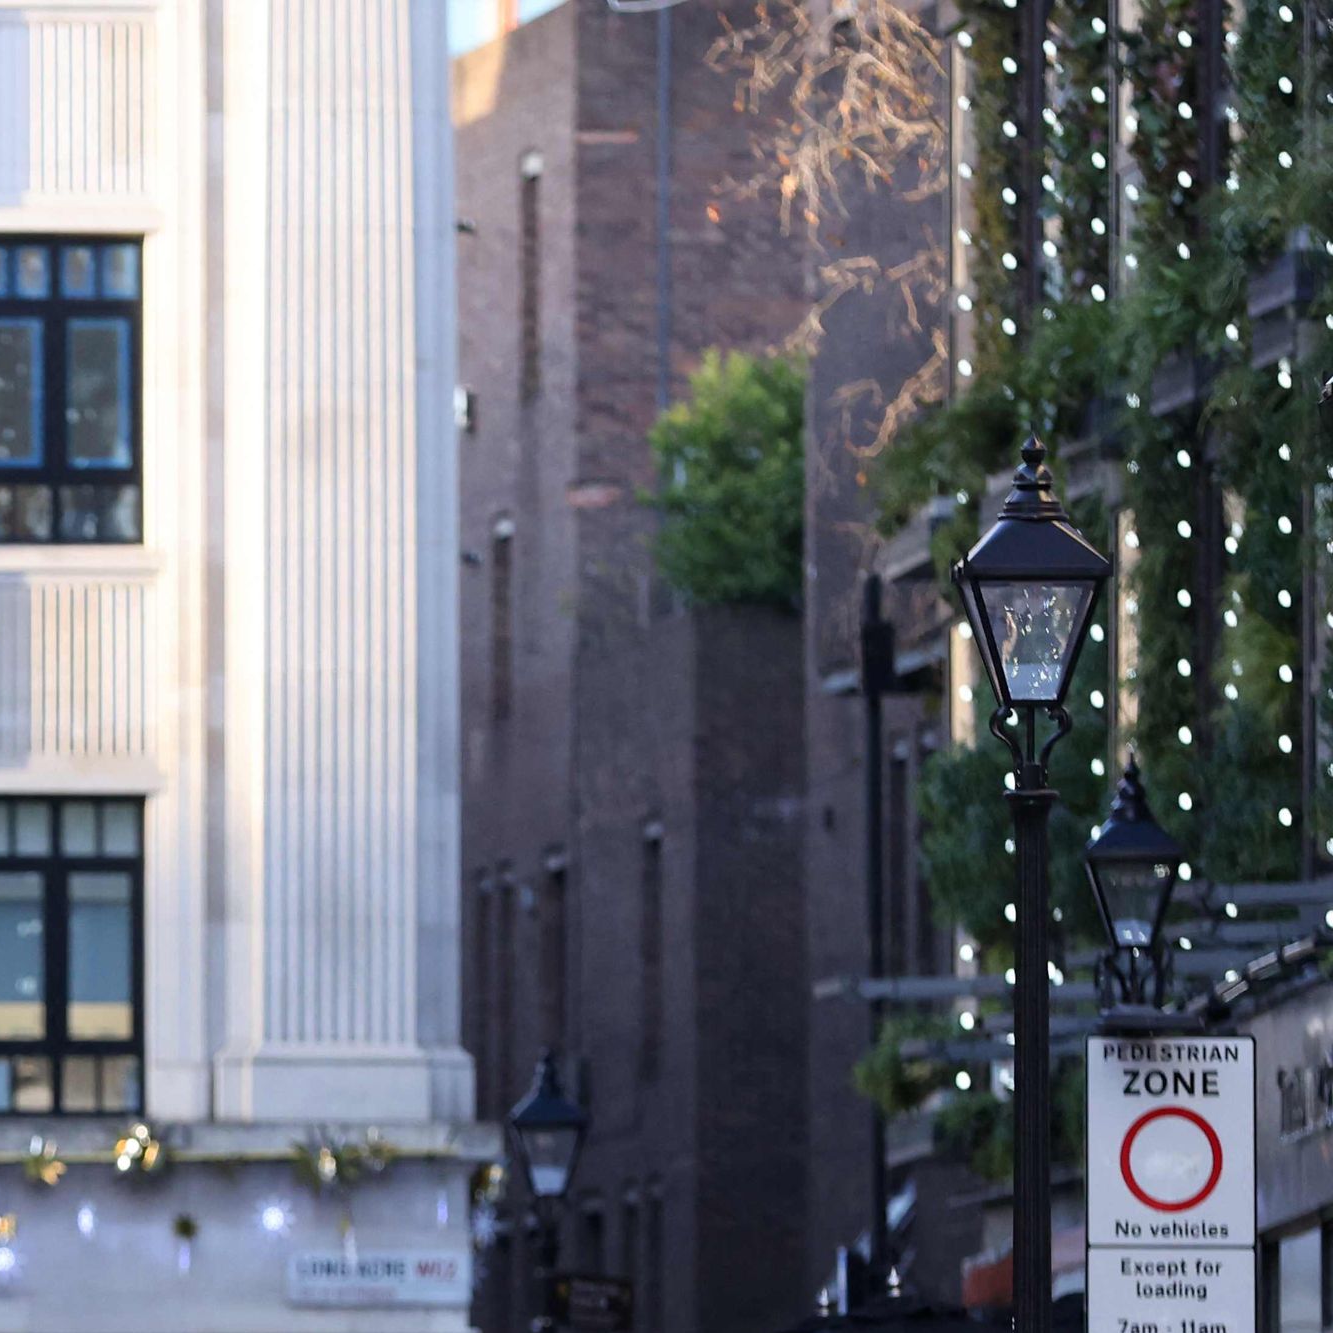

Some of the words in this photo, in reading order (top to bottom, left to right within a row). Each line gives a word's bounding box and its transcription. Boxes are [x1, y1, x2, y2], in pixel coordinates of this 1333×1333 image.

[1103, 1043, 1239, 1063] PEDESTRIAN
[1122, 1069, 1221, 1097] ZONE
[1114, 1219, 1142, 1239] No
[1150, 1219, 1229, 1239] vehicles
[1120, 1257, 1188, 1278] Except
[1196, 1257, 1224, 1277] for
[1136, 1280, 1208, 1302] loading
